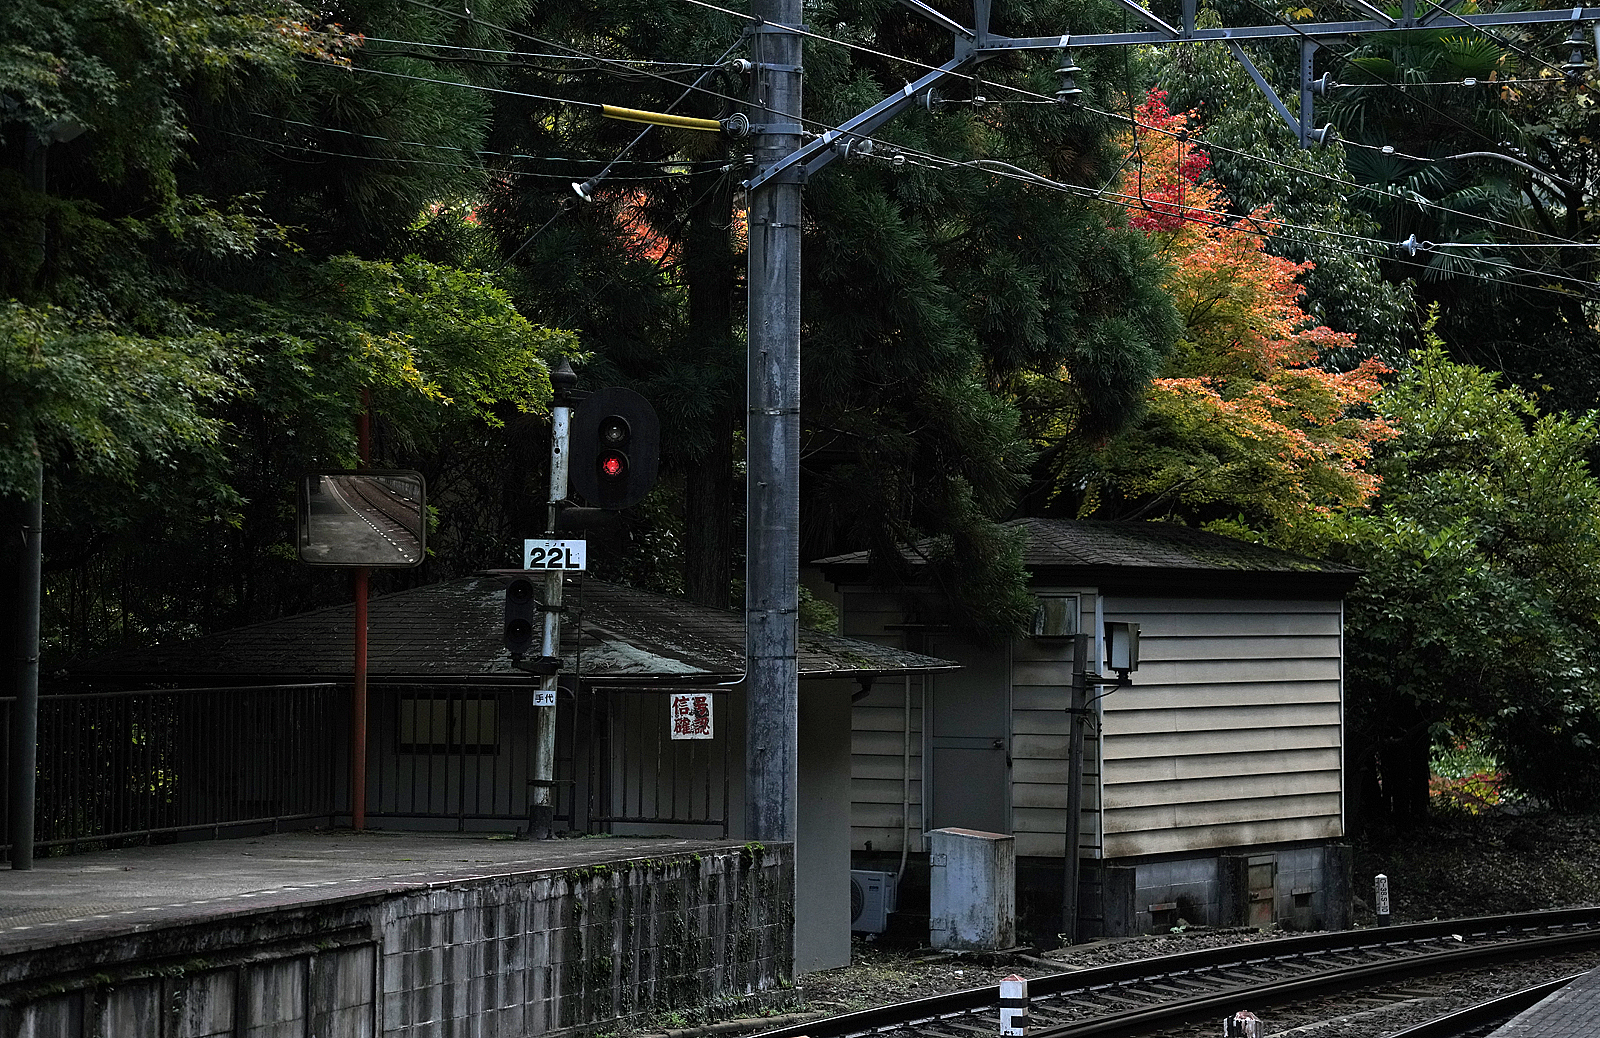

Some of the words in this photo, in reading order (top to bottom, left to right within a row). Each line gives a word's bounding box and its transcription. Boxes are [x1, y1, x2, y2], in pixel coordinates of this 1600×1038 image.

[530, 547, 580, 569] 22L
[672, 695, 709, 716] 信号
[673, 716, 710, 736] 確認
